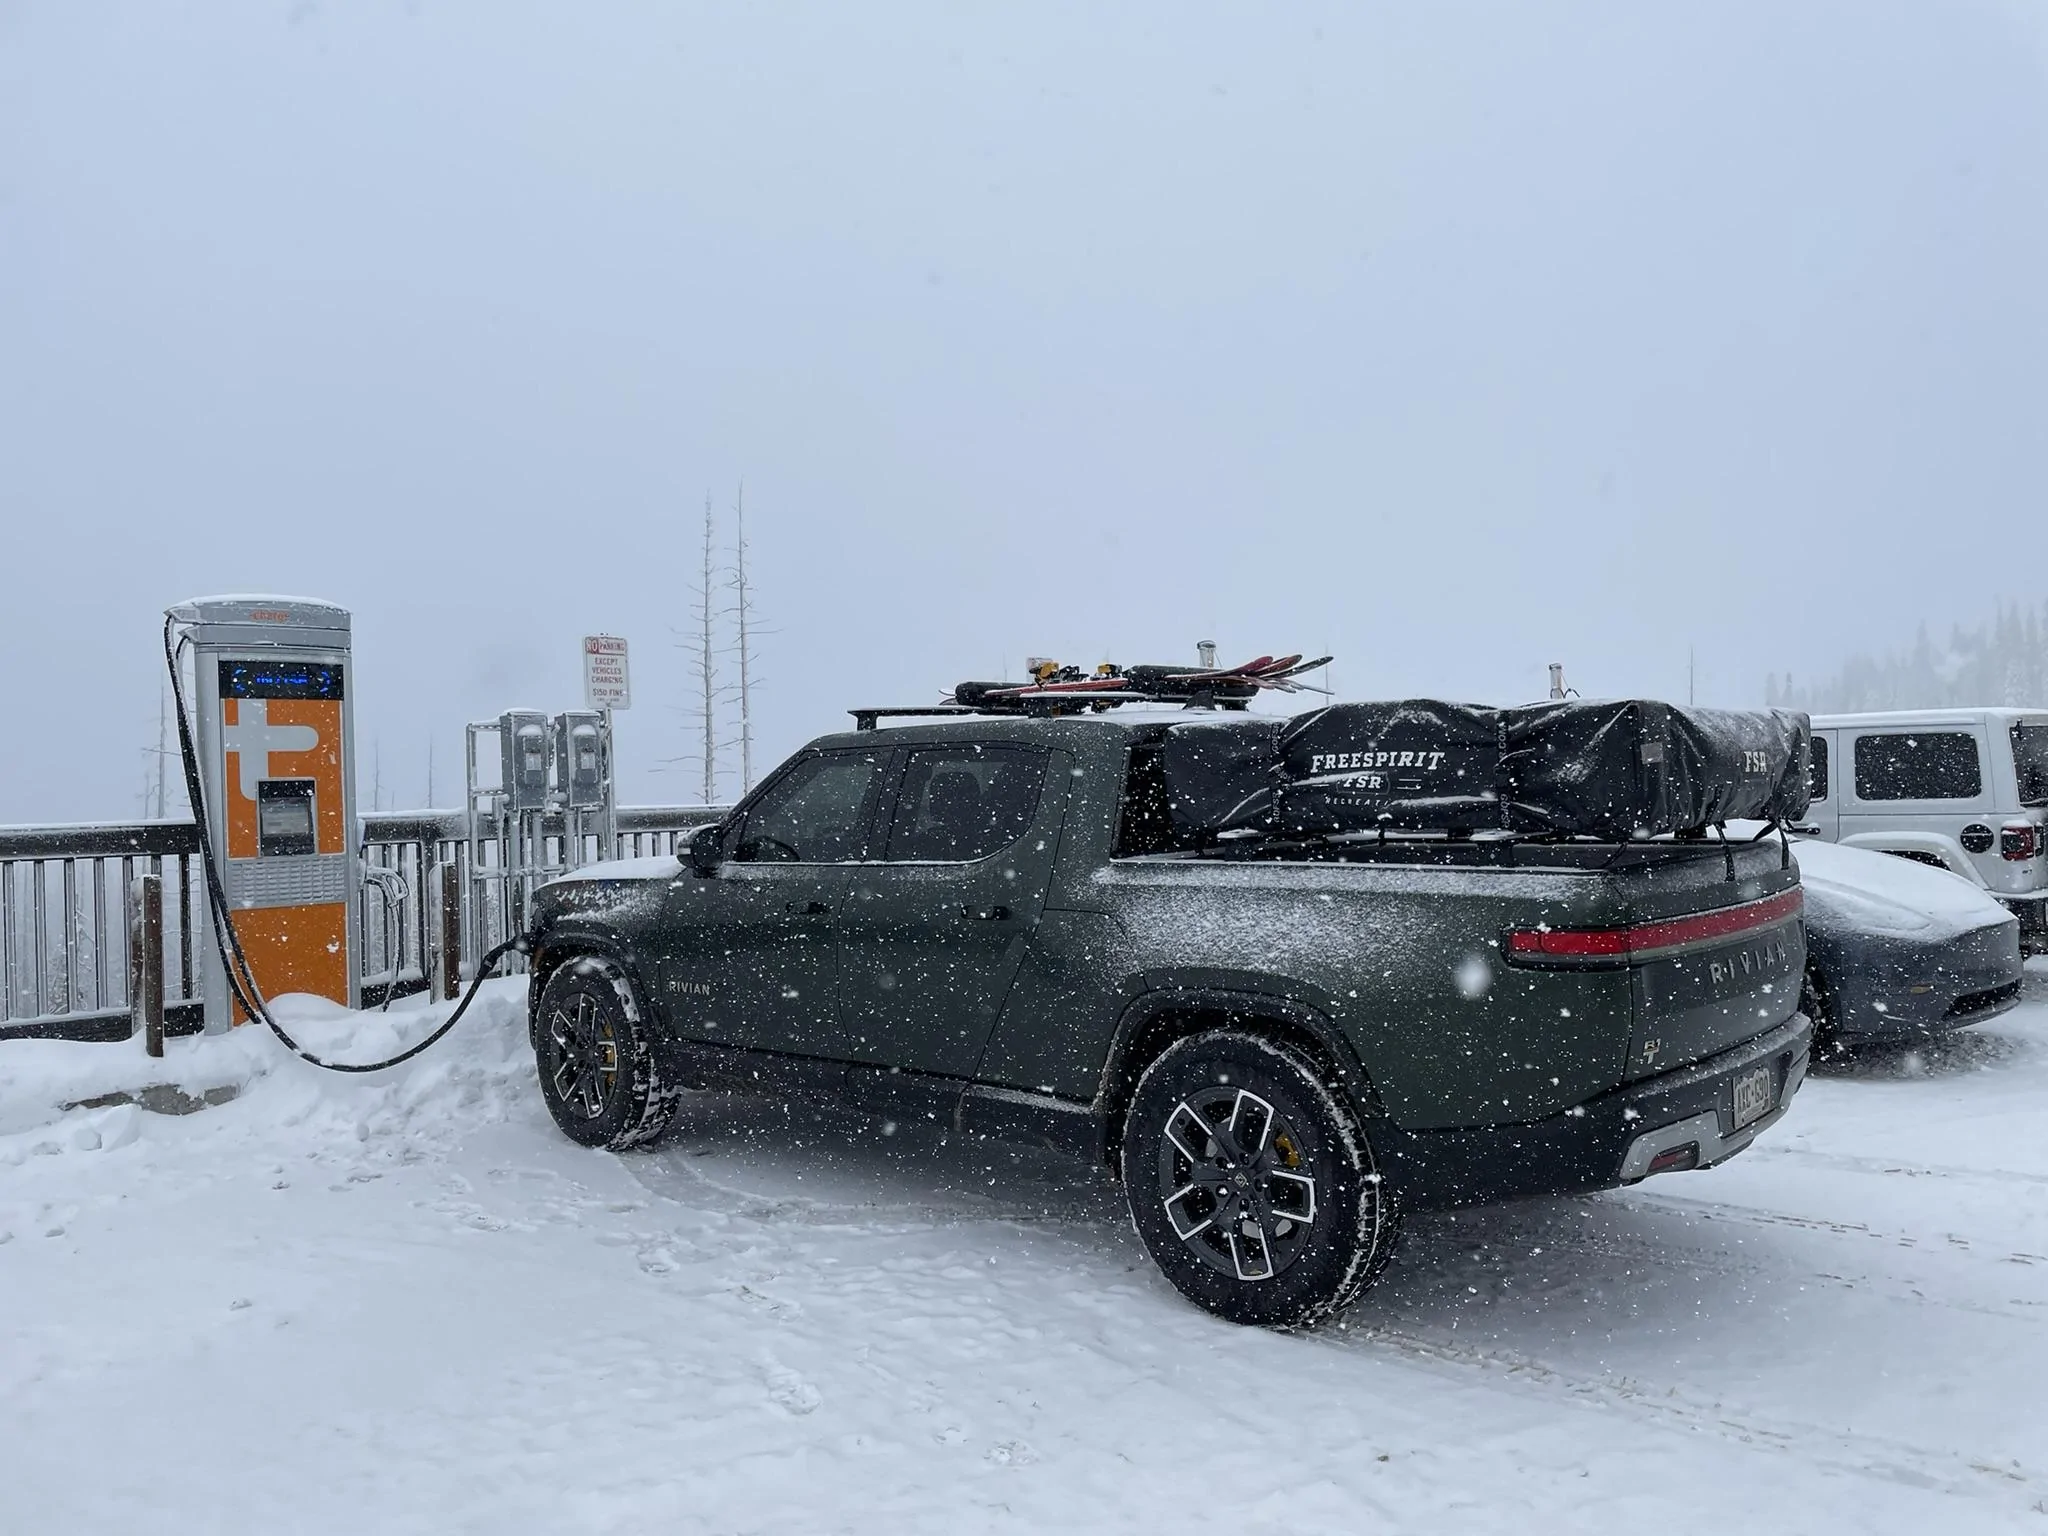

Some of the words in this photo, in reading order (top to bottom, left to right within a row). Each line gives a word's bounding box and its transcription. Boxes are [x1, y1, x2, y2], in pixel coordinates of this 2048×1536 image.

[586, 639, 598, 652] NO
[600, 641, 625, 651] PARKING
[594, 657, 618, 666] EXCEPT
[592, 667, 622, 675] VEHICLES
[592, 676, 624, 684] CHARGING
[592, 688, 608, 697] $150
[609, 688, 624, 697] FINE
[1310, 751, 1446, 774] FREESPIRIT
[1743, 751, 1767, 773] FSR
[1709, 940, 1787, 985] RIVIAN
[669, 981, 710, 996] RIVIAN
